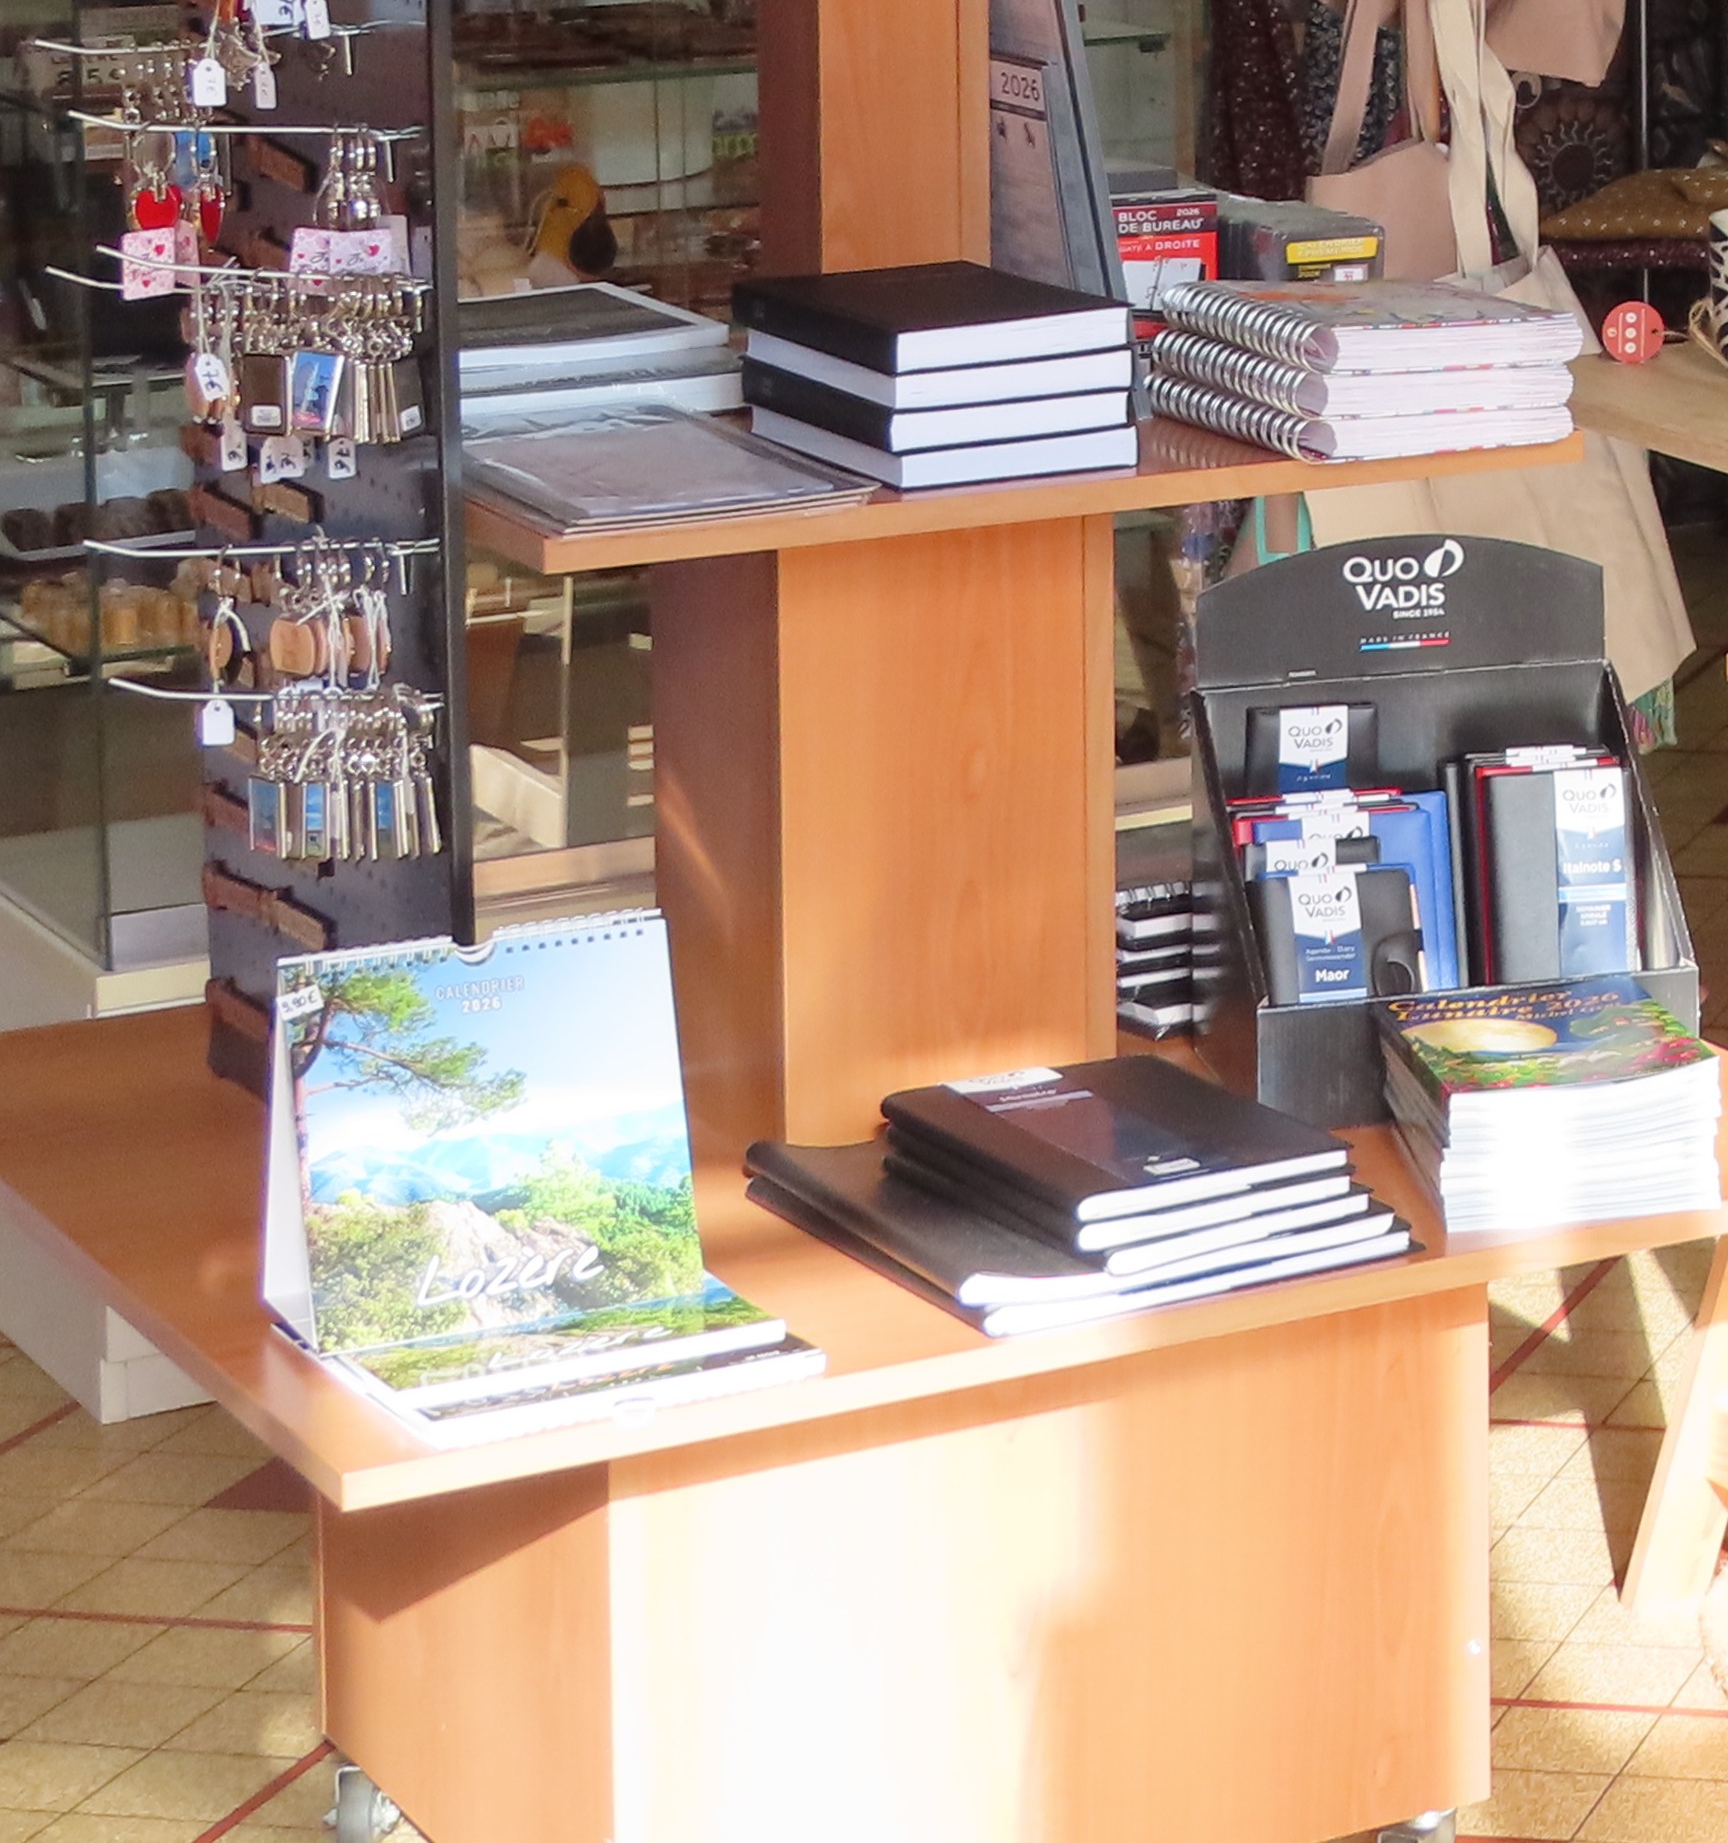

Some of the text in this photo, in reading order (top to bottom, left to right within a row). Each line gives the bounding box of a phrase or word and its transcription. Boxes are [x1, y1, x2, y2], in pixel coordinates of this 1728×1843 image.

[1001, 72, 1041, 102] 2026
[1118, 208, 1200, 223] BLOC 2026
[1118, 218, 1203, 234] DE BUREAU
[1155, 239, 1200, 251] DROITE
[1343, 556, 1420, 584] QUO
[1355, 582, 1446, 611] VADIS
[1392, 608, 1421, 619] SINCE
[1408, 631, 1450, 640] FRANCE
[1288, 725, 1323, 738] QUO
[1293, 737, 1334, 750] VADIS
[1562, 789, 1597, 802] QUO
[1569, 802, 1609, 814] VADIS
[1274, 859, 1310, 872] QUO
[1563, 858, 1622, 875] Italnote S
[1298, 893, 1333, 906] QUO
[1305, 906, 1346, 919] VADIS
[1315, 968, 1350, 983] Maor
[434, 975, 525, 1001] CALENDRIER
[461, 996, 502, 1014] 2026
[1387, 990, 1574, 1012] Calendrier
[415, 1245, 605, 1306] Lozère
